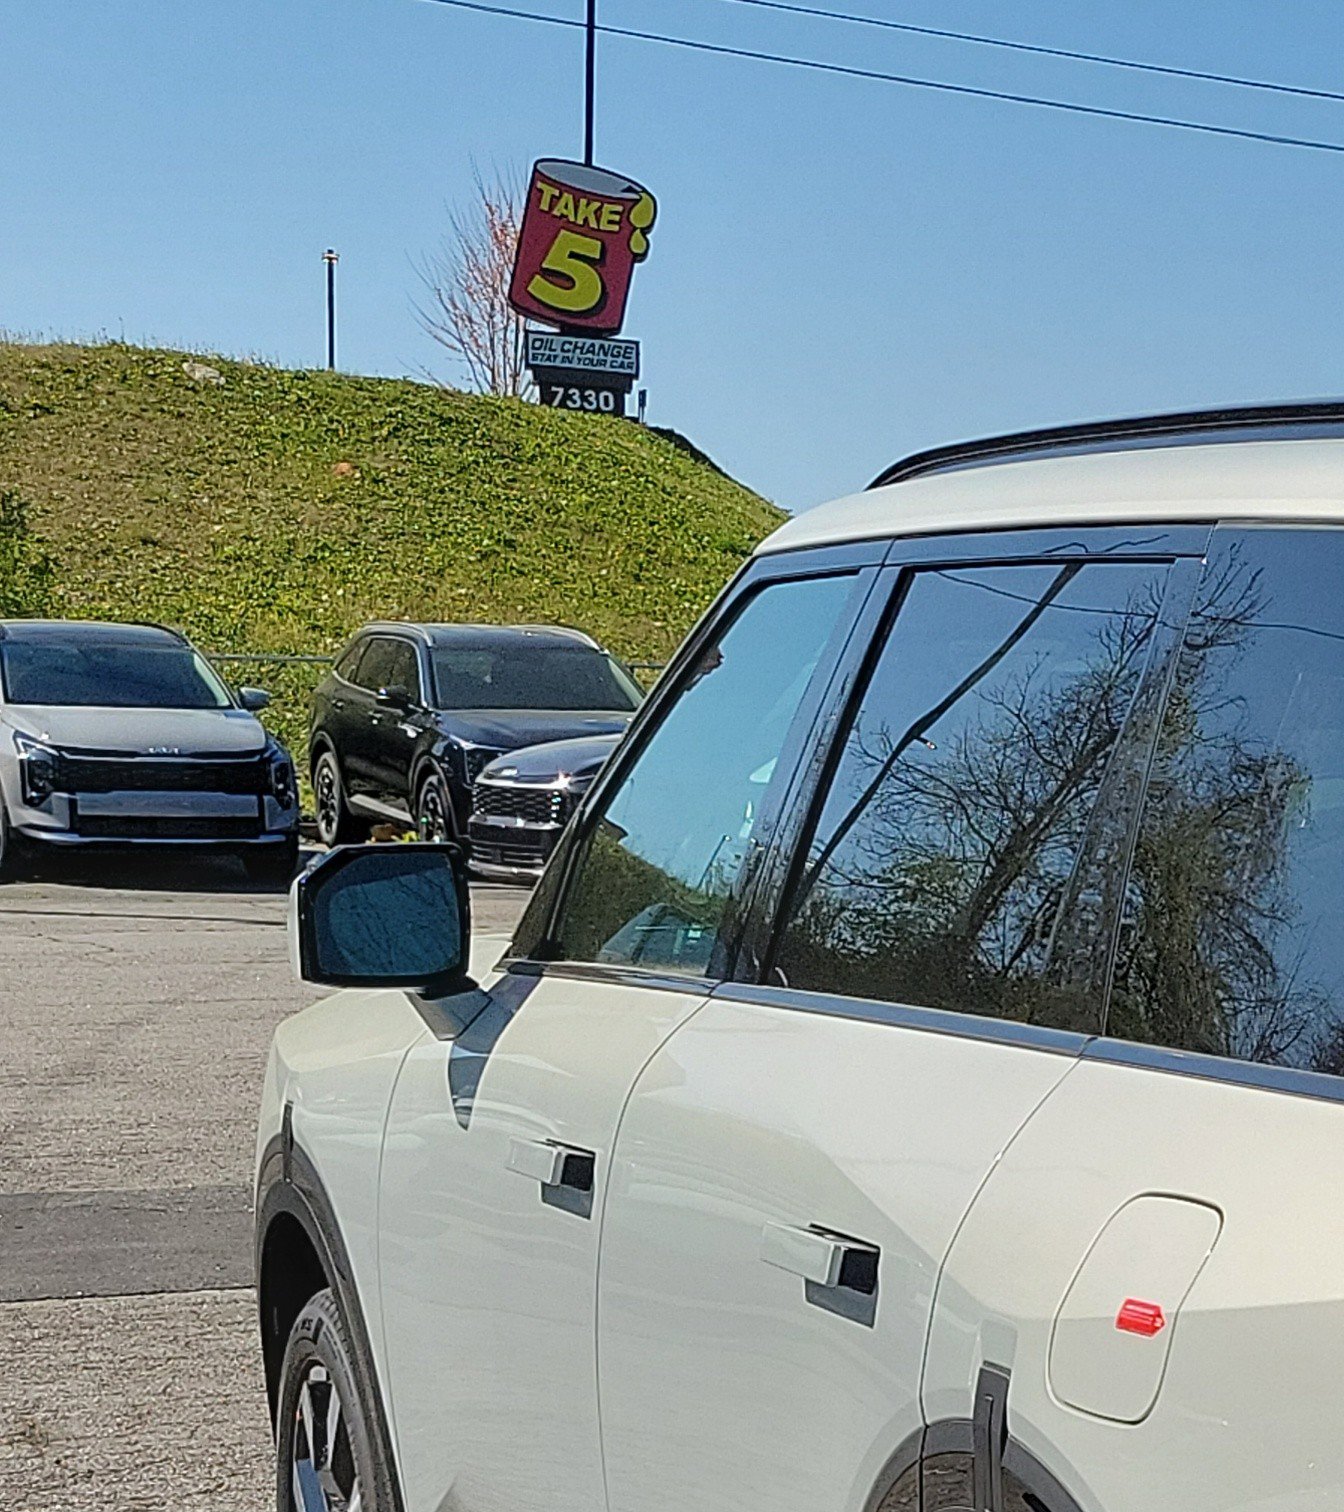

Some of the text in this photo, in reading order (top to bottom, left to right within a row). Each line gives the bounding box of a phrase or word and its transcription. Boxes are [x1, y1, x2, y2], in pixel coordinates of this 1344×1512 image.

[536, 181, 624, 232] TAKE
[526, 229, 603, 312] 5
[531, 337, 635, 360] OIL CHANGE
[560, 355, 574, 365] IN
[576, 356, 607, 367] YOUR
[609, 360, 635, 370] CAR
[551, 386, 615, 411] 7330
